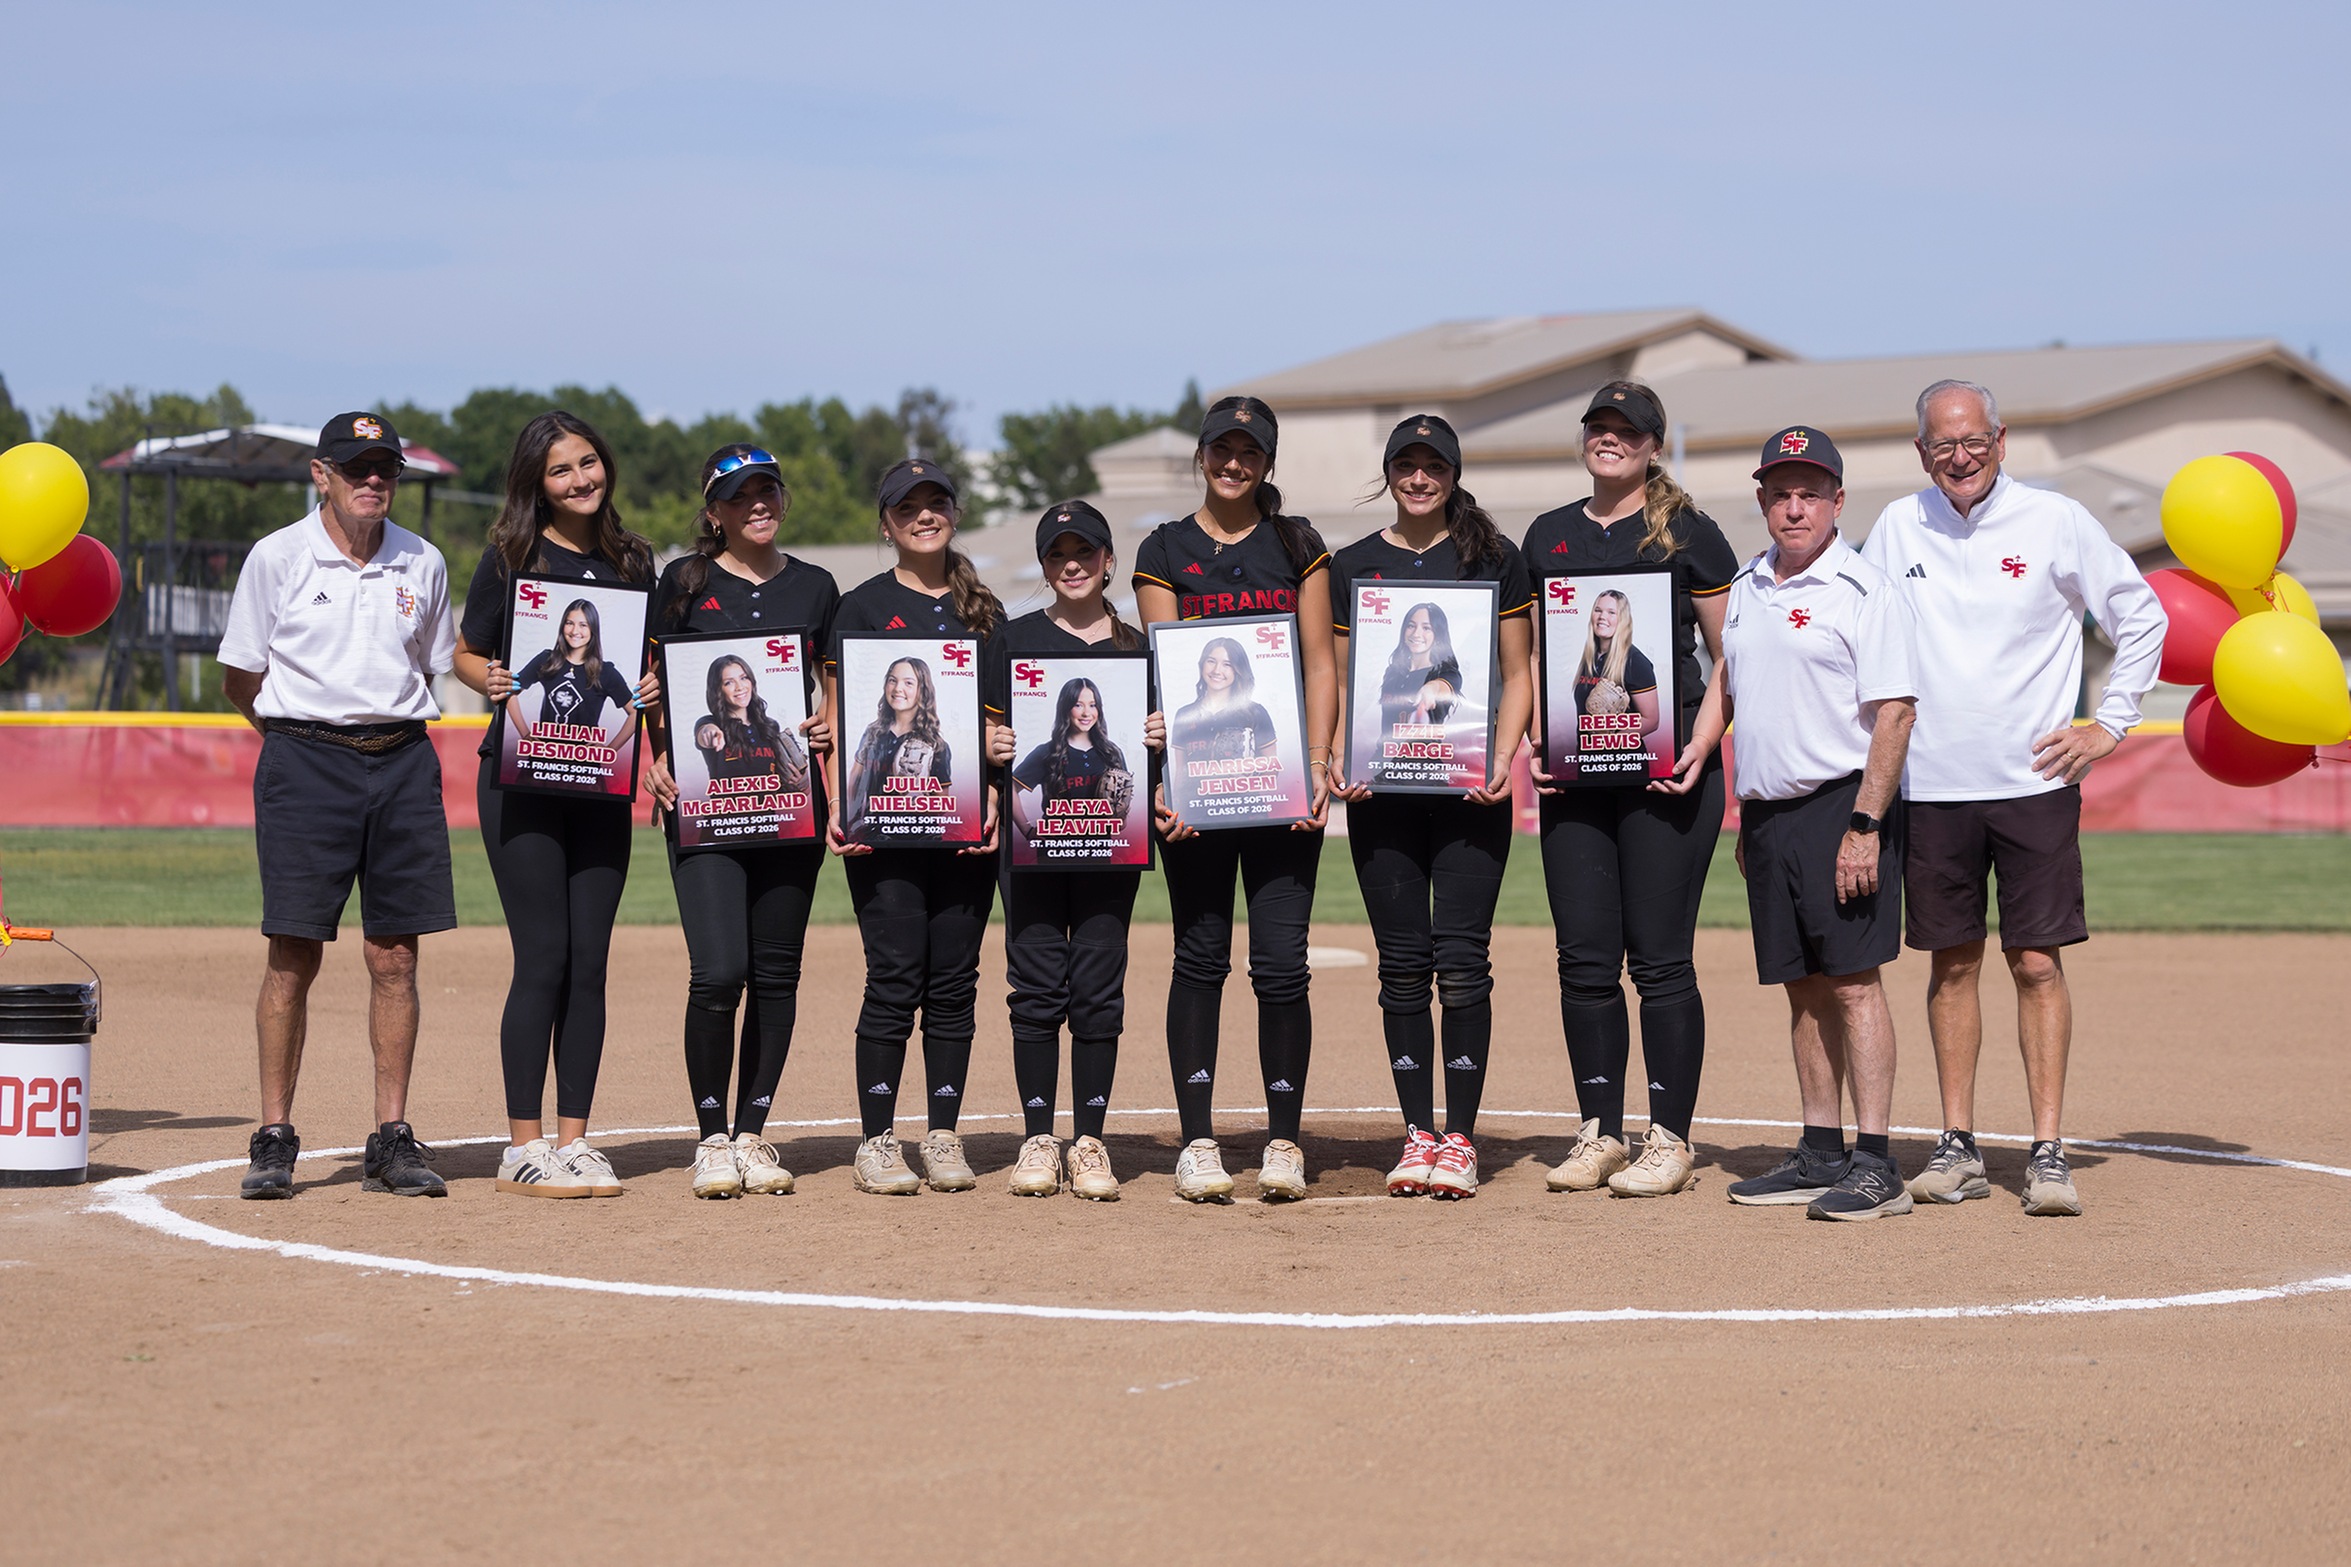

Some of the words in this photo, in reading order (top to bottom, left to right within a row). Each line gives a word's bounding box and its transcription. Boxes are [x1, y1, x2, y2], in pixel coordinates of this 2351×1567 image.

[353, 417, 382, 439] SF
[1780, 432, 1808, 454] SF
[2001, 557, 2027, 578] SF
[518, 583, 549, 610] SF
[1548, 580, 1576, 606] SF
[1361, 590, 1391, 616] SF
[1788, 609, 1811, 629] SF
[1255, 626, 1286, 651] SF
[766, 639, 796, 664] SF
[942, 642, 972, 668] SF
[1015, 662, 1045, 688] SF
[1578, 713, 1642, 731] REESE
[531, 722, 607, 743] LILLIAN
[1383, 742, 1454, 759] BARGE
[1580, 733, 1641, 751] LEWIS
[517, 740, 617, 764] DESMOND
[1564, 755, 1578, 764] ST.
[1578, 754, 1615, 763] FRANCIS
[1615, 752, 1658, 762] SOFTBALL
[517, 760, 531, 769] ST.
[532, 761, 569, 772] FRANCIS
[570, 764, 615, 777] SOFTBALL
[1187, 756, 1283, 778] MARISSA
[1368, 761, 1382, 770] ST.
[1383, 761, 1421, 771] FRANCIS
[1422, 762, 1468, 772] SOFTBALL
[1581, 763, 1608, 772] CLASS
[1609, 763, 1621, 772] OF
[1622, 762, 1642, 772] 2026
[533, 771, 561, 782] CLASS
[562, 774, 575, 783] OF
[575, 775, 597, 785] 2026
[706, 774, 780, 795] ALEXIS
[883, 777, 942, 792] JULIA
[1385, 771, 1414, 780] CLASS
[1415, 772, 1427, 780] OF
[1428, 772, 1450, 781] 2026
[1197, 775, 1277, 796] JENSEN
[682, 793, 807, 817] McFARLAND
[869, 797, 956, 812] NIELSEN
[1045, 798, 1113, 816] JAEYA
[1189, 799, 1203, 808] ST.
[1204, 796, 1243, 807] FRANCIS
[1243, 793, 1288, 805] SOFTBALL
[1207, 806, 1236, 816] CLASS
[1237, 805, 1250, 815] OF
[1250, 804, 1272, 814] 2026
[696, 819, 710, 828] ST.
[711, 816, 750, 827] FRANCIS
[750, 813, 796, 824] SOFTBALL
[864, 816, 878, 824] ST.
[879, 816, 917, 825] FRANCIS
[918, 816, 963, 825] SOFTBALL
[1036, 818, 1123, 836] LEAVITT
[714, 827, 742, 836] CLASS
[744, 826, 756, 834] OF
[757, 825, 780, 834] 2026
[881, 826, 910, 834] CLASS
[911, 826, 924, 834] OF
[924, 826, 946, 834] 2026
[1029, 839, 1044, 848] ST.
[1045, 839, 1084, 848] FRANCIS
[1084, 839, 1130, 848] SOFTBALL
[1047, 849, 1076, 857] CLASS
[1077, 849, 1090, 857] OF
[1091, 849, 1113, 857] 2026
